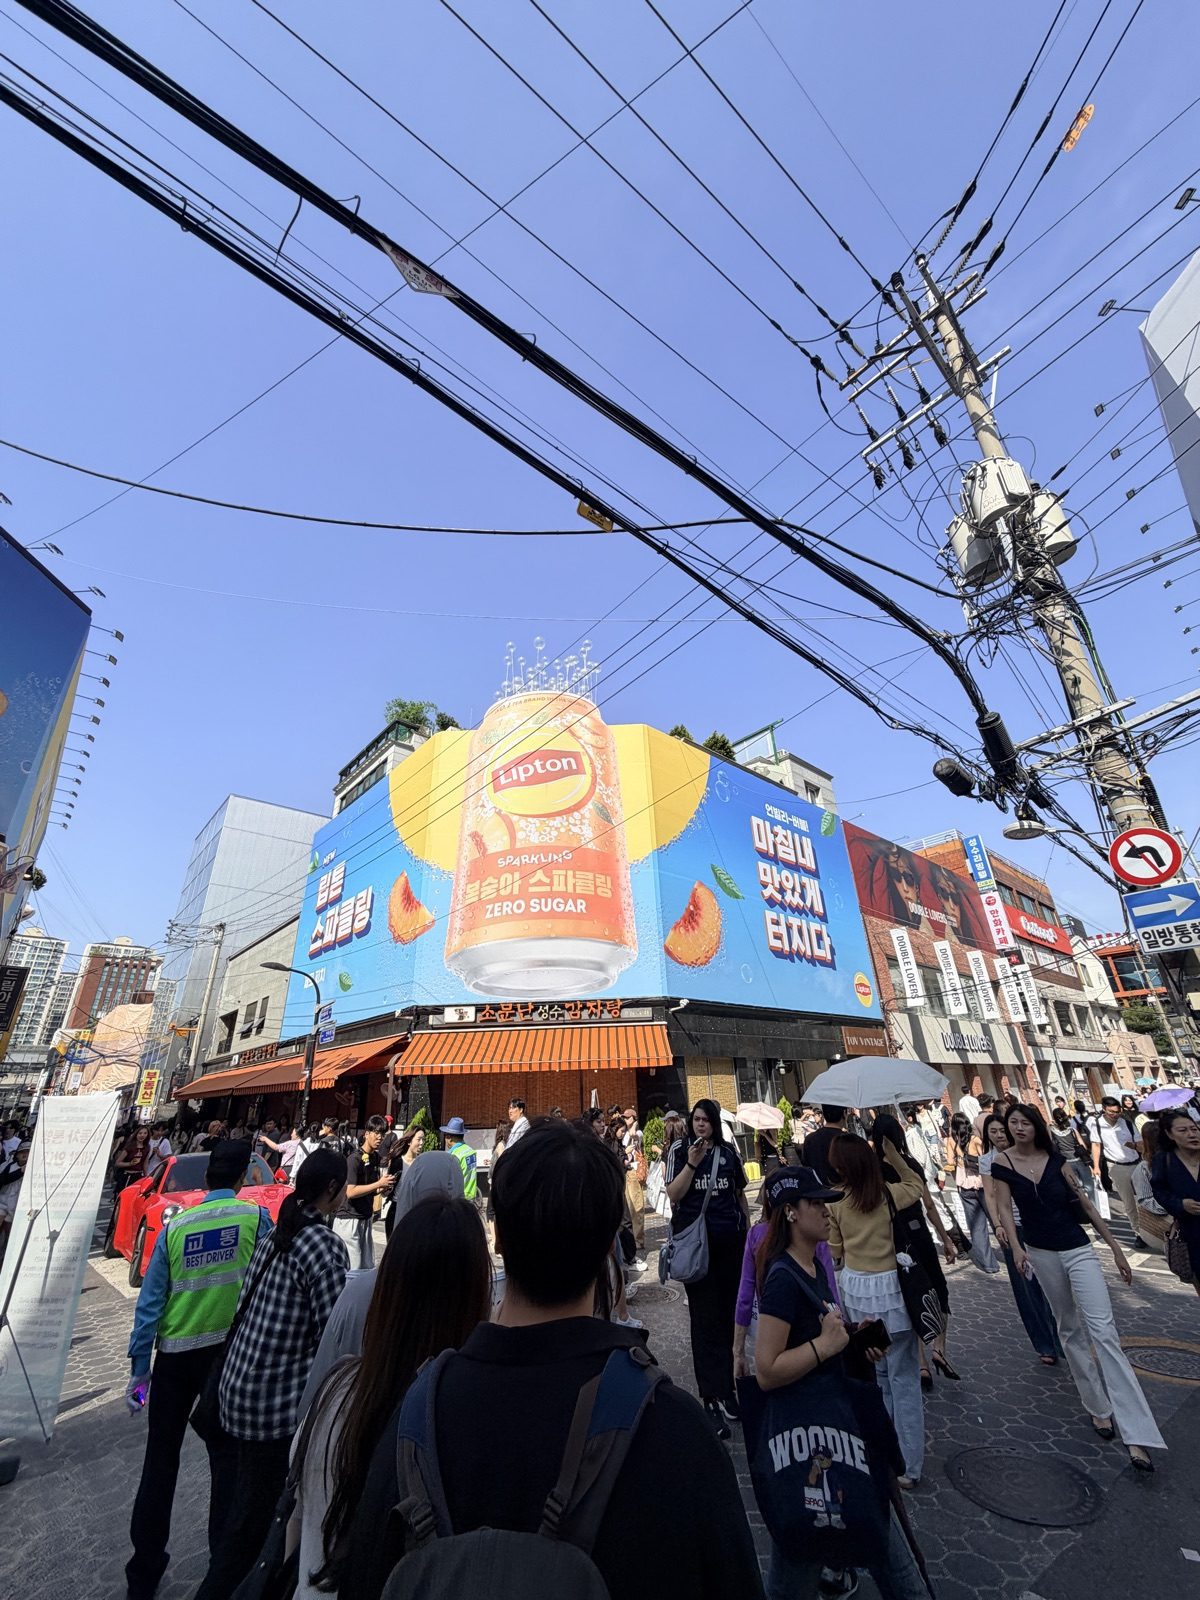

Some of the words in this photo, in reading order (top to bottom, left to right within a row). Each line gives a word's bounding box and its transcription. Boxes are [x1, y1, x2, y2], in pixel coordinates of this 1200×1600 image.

[498, 756, 578, 784] Lipton
[497, 850, 574, 868] SPARKLING
[750, 815, 817, 875] 마침내
[316, 860, 346, 913] 립톤
[464, 871, 521, 904] 복숭아
[528, 868, 613, 899] 스파클링
[757, 861, 825, 918] 맛있게
[308, 885, 373, 957] 스파클링
[485, 899, 526, 919] ZERO
[529, 897, 587, 914] SUGAR
[764, 909, 833, 964] 터지다
[989, 909, 1009, 945] 만화카페
[896, 935, 912, 967] DOUBLE
[905, 967, 919, 1000] LOVERS
[939, 948, 954, 978] DOUBLE
[948, 978, 962, 1007] LOVERS
[972, 957, 986, 984] DOUBLE
[980, 985, 994, 1012] LOVERS
[478, 1002, 535, 1023] 소문난
[537, 1004, 563, 1021] 성수
[565, 999, 623, 1020] 감자탕
[1008, 990, 1021, 1016] LOVERS
[1029, 994, 1042, 1019] LOVERS
[859, 1037, 885, 1047] VINTAGE
[140, 1071, 157, 1100] 부동산
[780, 1178, 799, 1189] YORK
[186, 1254, 204, 1268] BEST
[206, 1249, 235, 1264] DRIVER
[768, 1425, 871, 1476] WOODIE
